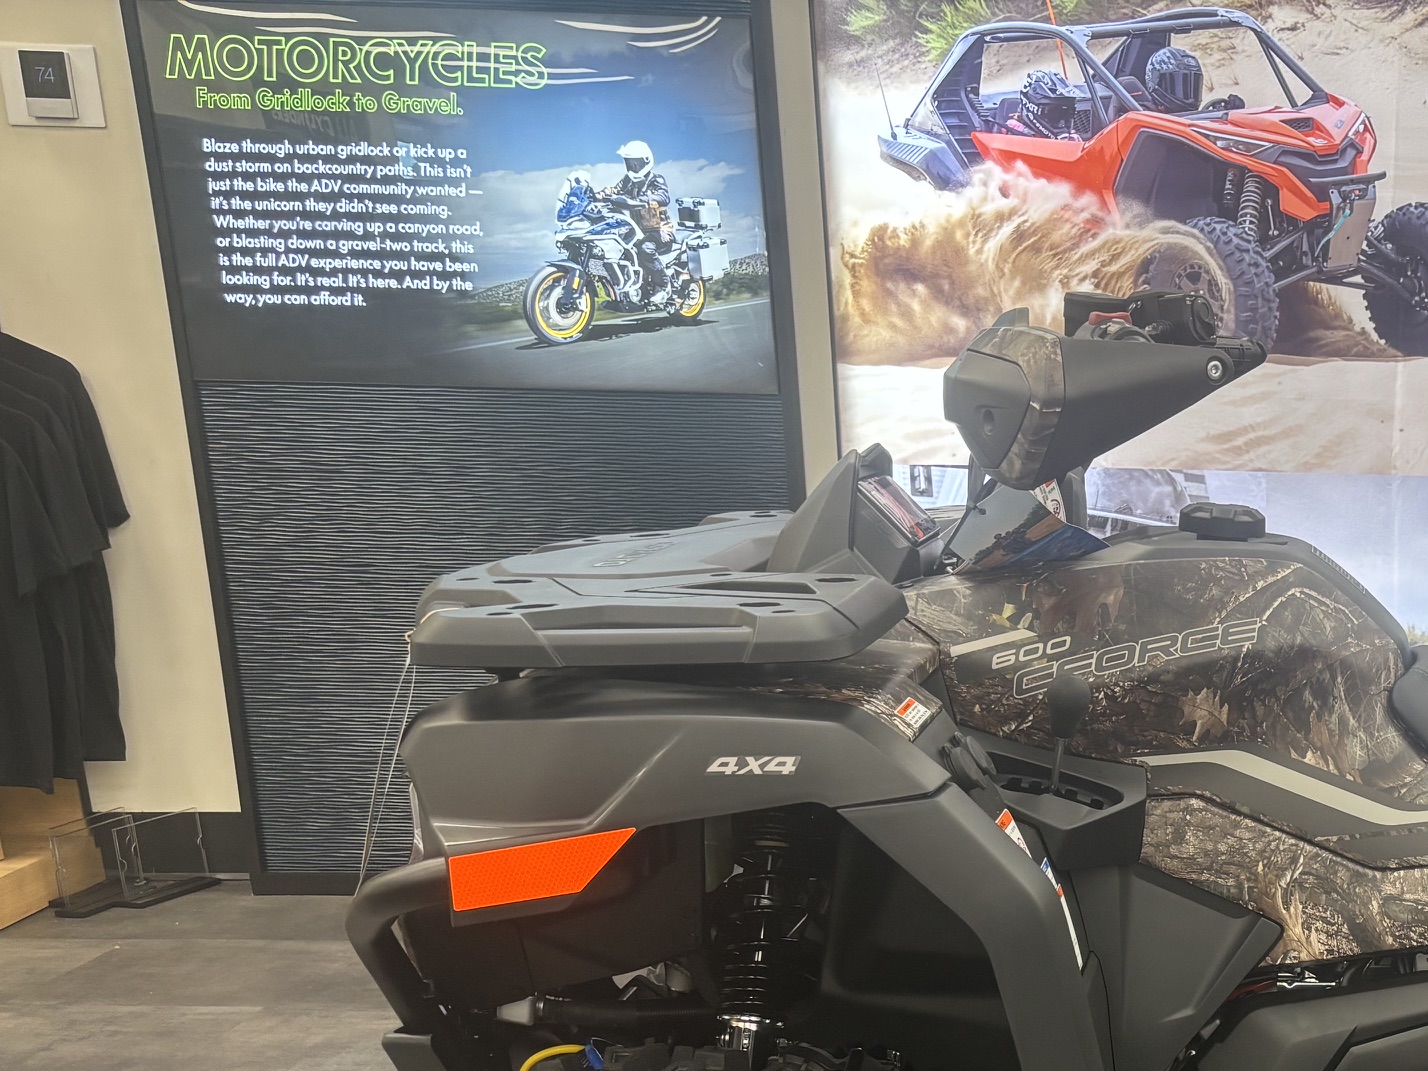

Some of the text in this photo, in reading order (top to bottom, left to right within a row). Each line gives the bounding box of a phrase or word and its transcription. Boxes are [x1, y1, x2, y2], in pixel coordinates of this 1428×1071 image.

[165, 34, 548, 90] MOTORCYCLES
[34, 67, 54, 82] 74
[196, 86, 251, 110] From
[256, 88, 350, 113] Gridlock
[354, 94, 378, 113] to
[382, 92, 464, 116] Gravel.
[1020, 94, 1038, 114] FXR
[202, 138, 466, 162] Blaze through urban gridlock or kick up a
[205, 157, 472, 178] dust storm on backcountry paths. This isn't
[207, 177, 466, 198] just the bike the ADV community wanted
[210, 196, 452, 218] it's the unicorn they didn't see coming.
[212, 214, 484, 237] Whether you're carving up a canyon road,
[216, 234, 474, 254] or blasting down a gravel-two track, this
[218, 252, 478, 273] is the full ADV experience you have been
[220, 270, 473, 293] looking for. It's real. It's here. And by the
[223, 290, 366, 307] way, you can afford it.
[992, 635, 1071, 670] 600
[1014, 618, 1260, 699] CFORCE
[706, 756, 798, 774] 4X4
